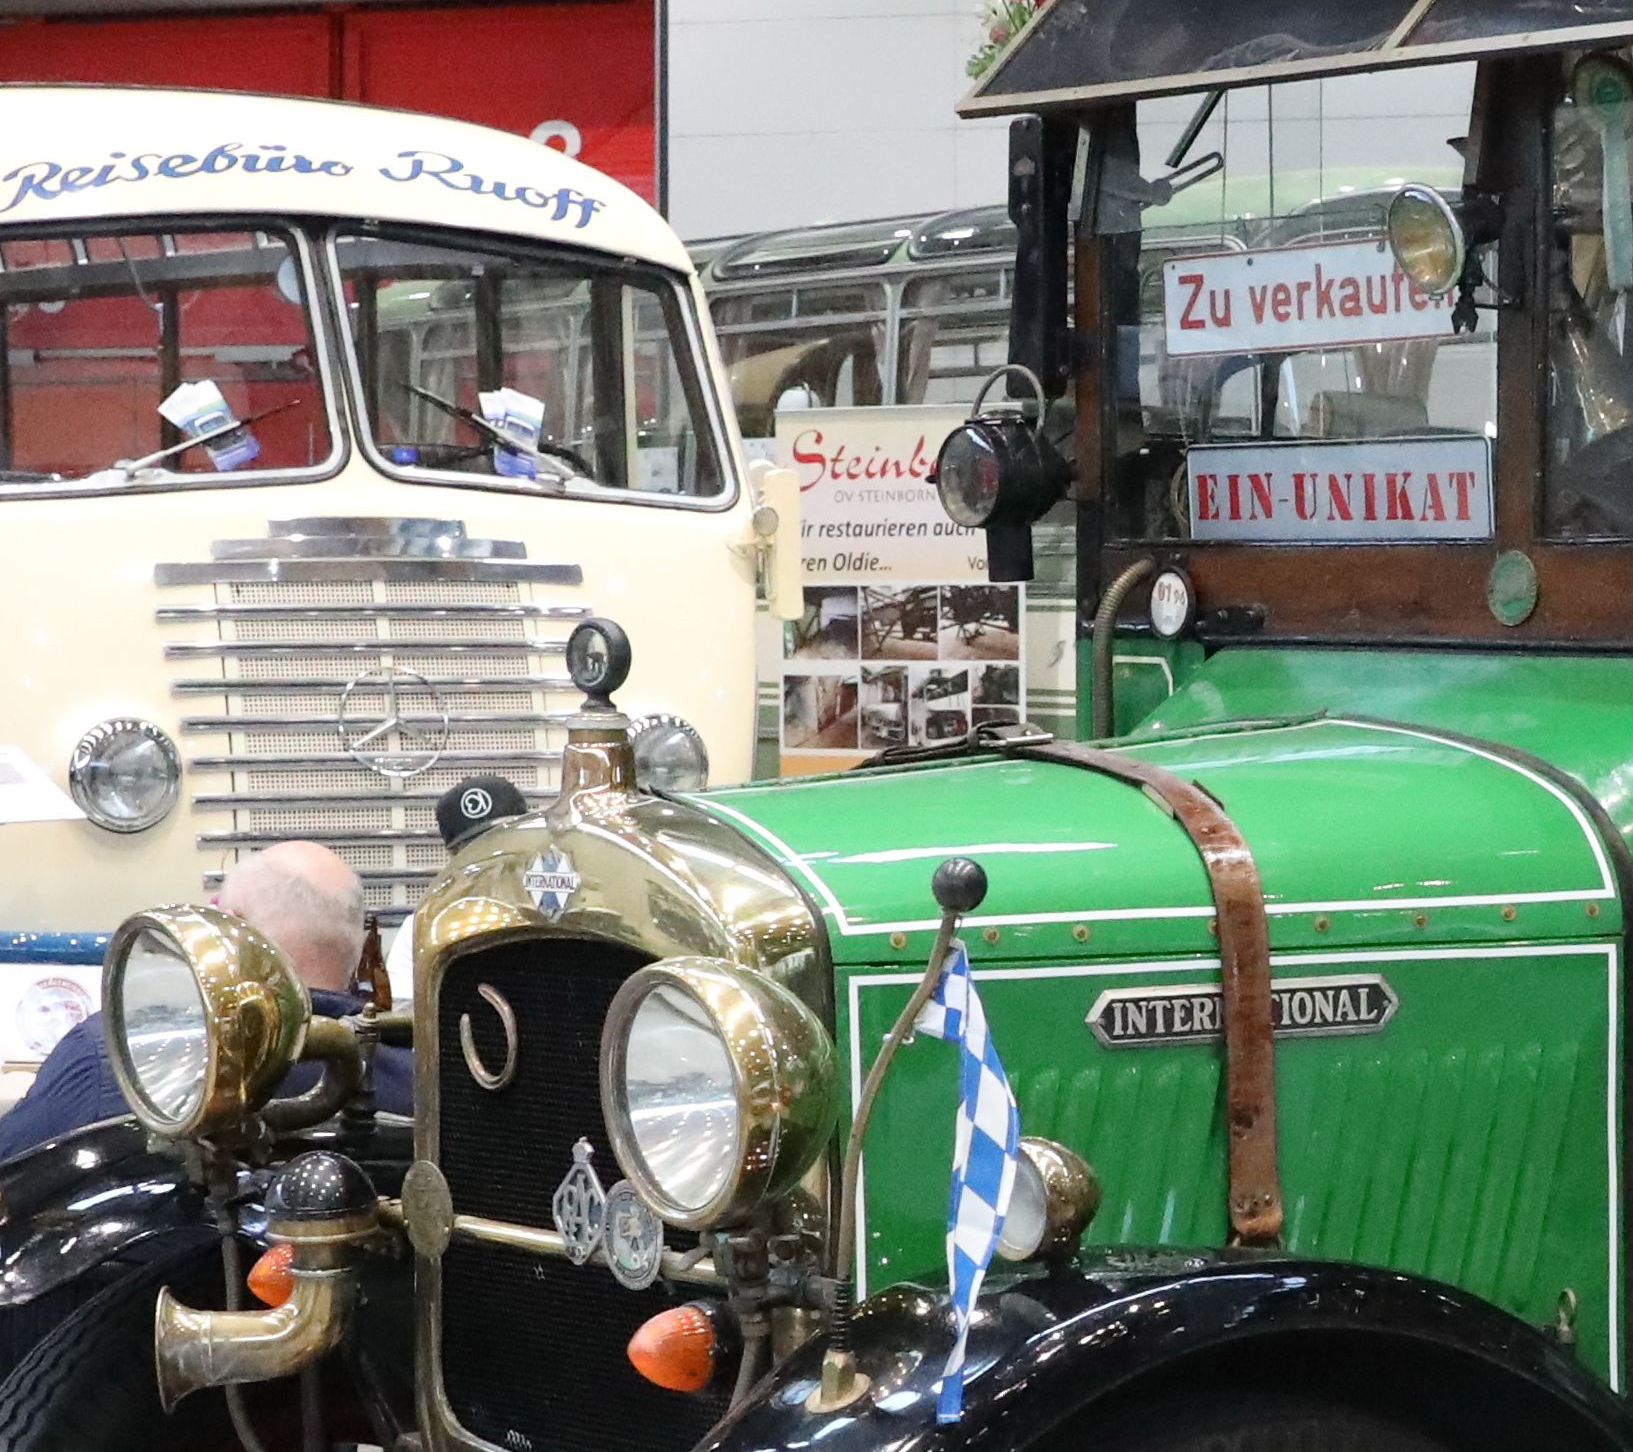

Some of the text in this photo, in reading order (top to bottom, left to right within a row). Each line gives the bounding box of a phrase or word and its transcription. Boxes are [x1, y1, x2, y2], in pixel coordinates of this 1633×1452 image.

[378, 149, 608, 229] Ruoff
[1177, 272, 1232, 331] Zu
[1195, 471, 1476, 522] EIN-UNIKAT
[801, 519, 814, 538] ir
[818, 518, 928, 539] restaurieren
[1111, 987, 1379, 1037] INTERIONAL
